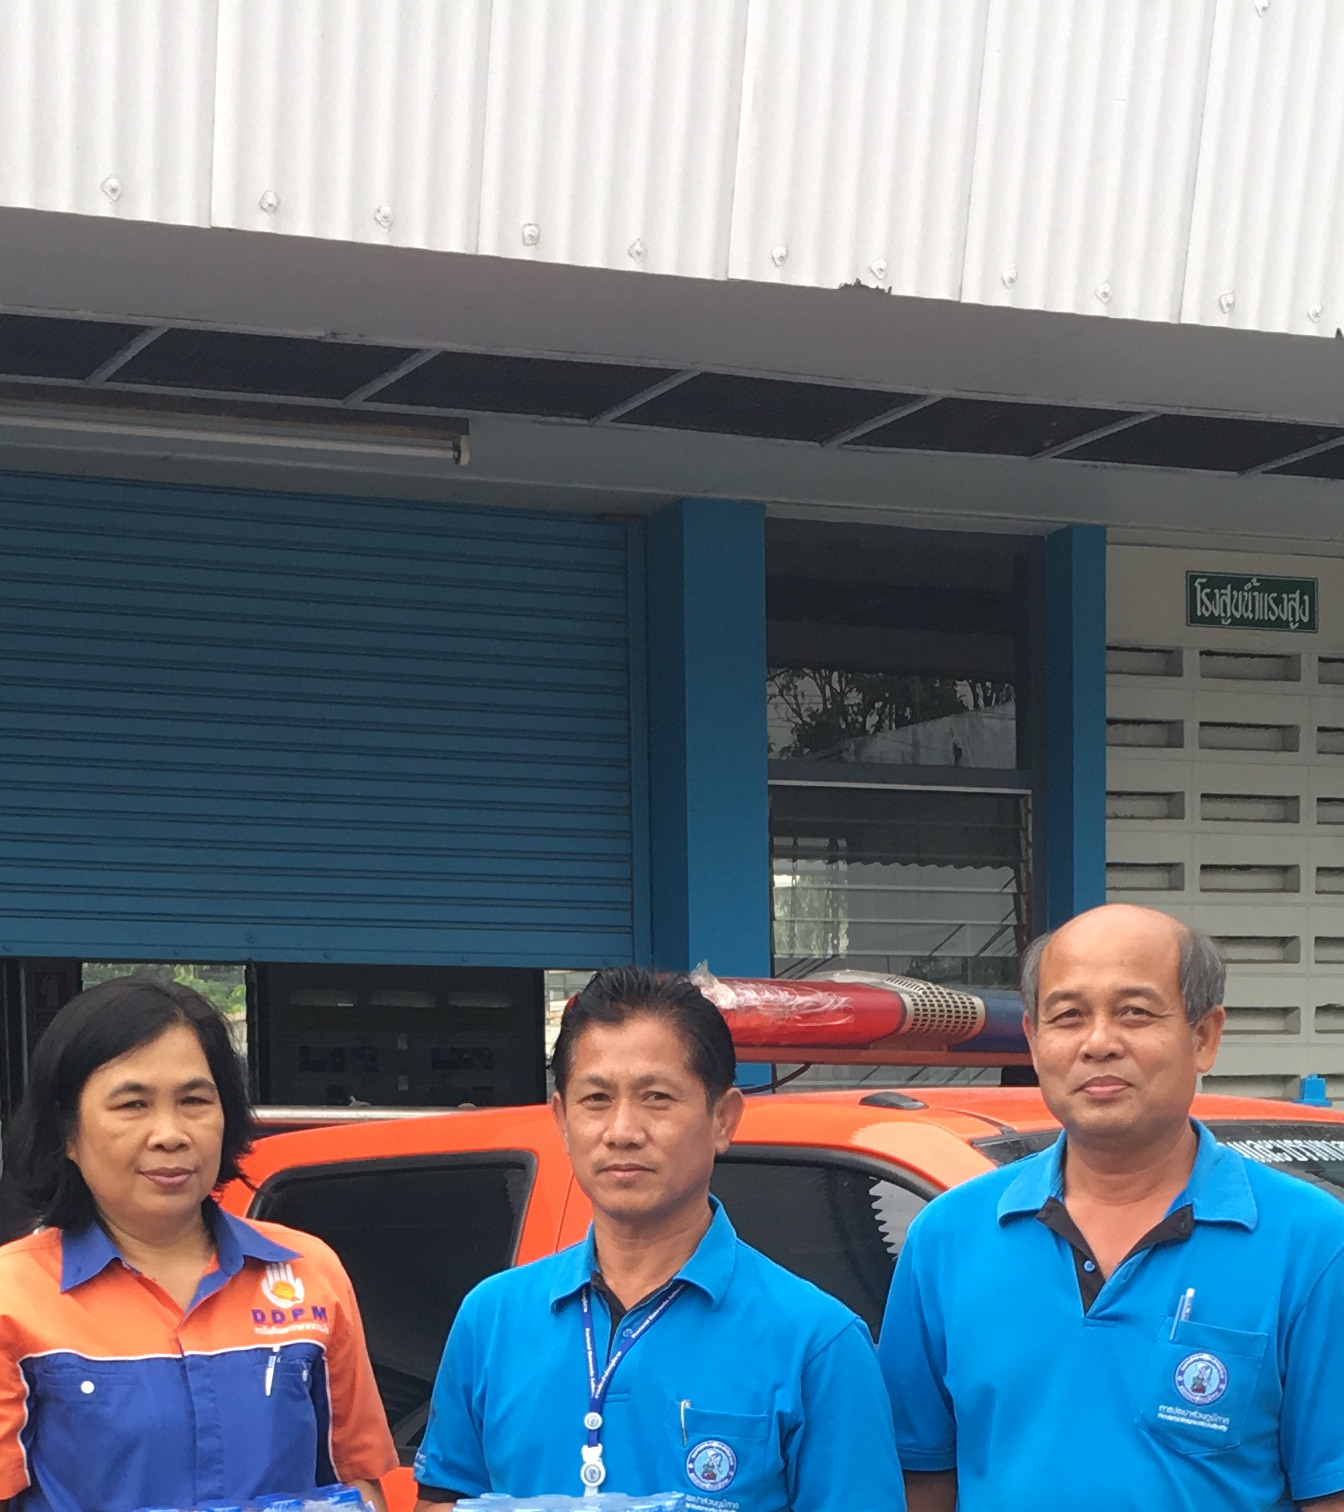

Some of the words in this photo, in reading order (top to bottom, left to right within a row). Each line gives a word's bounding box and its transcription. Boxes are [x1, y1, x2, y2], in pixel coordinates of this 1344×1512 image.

[1194, 577, 1310, 630] โรงสูบน้ำแรงสูง
[251, 1305, 328, 1324] DDPM
